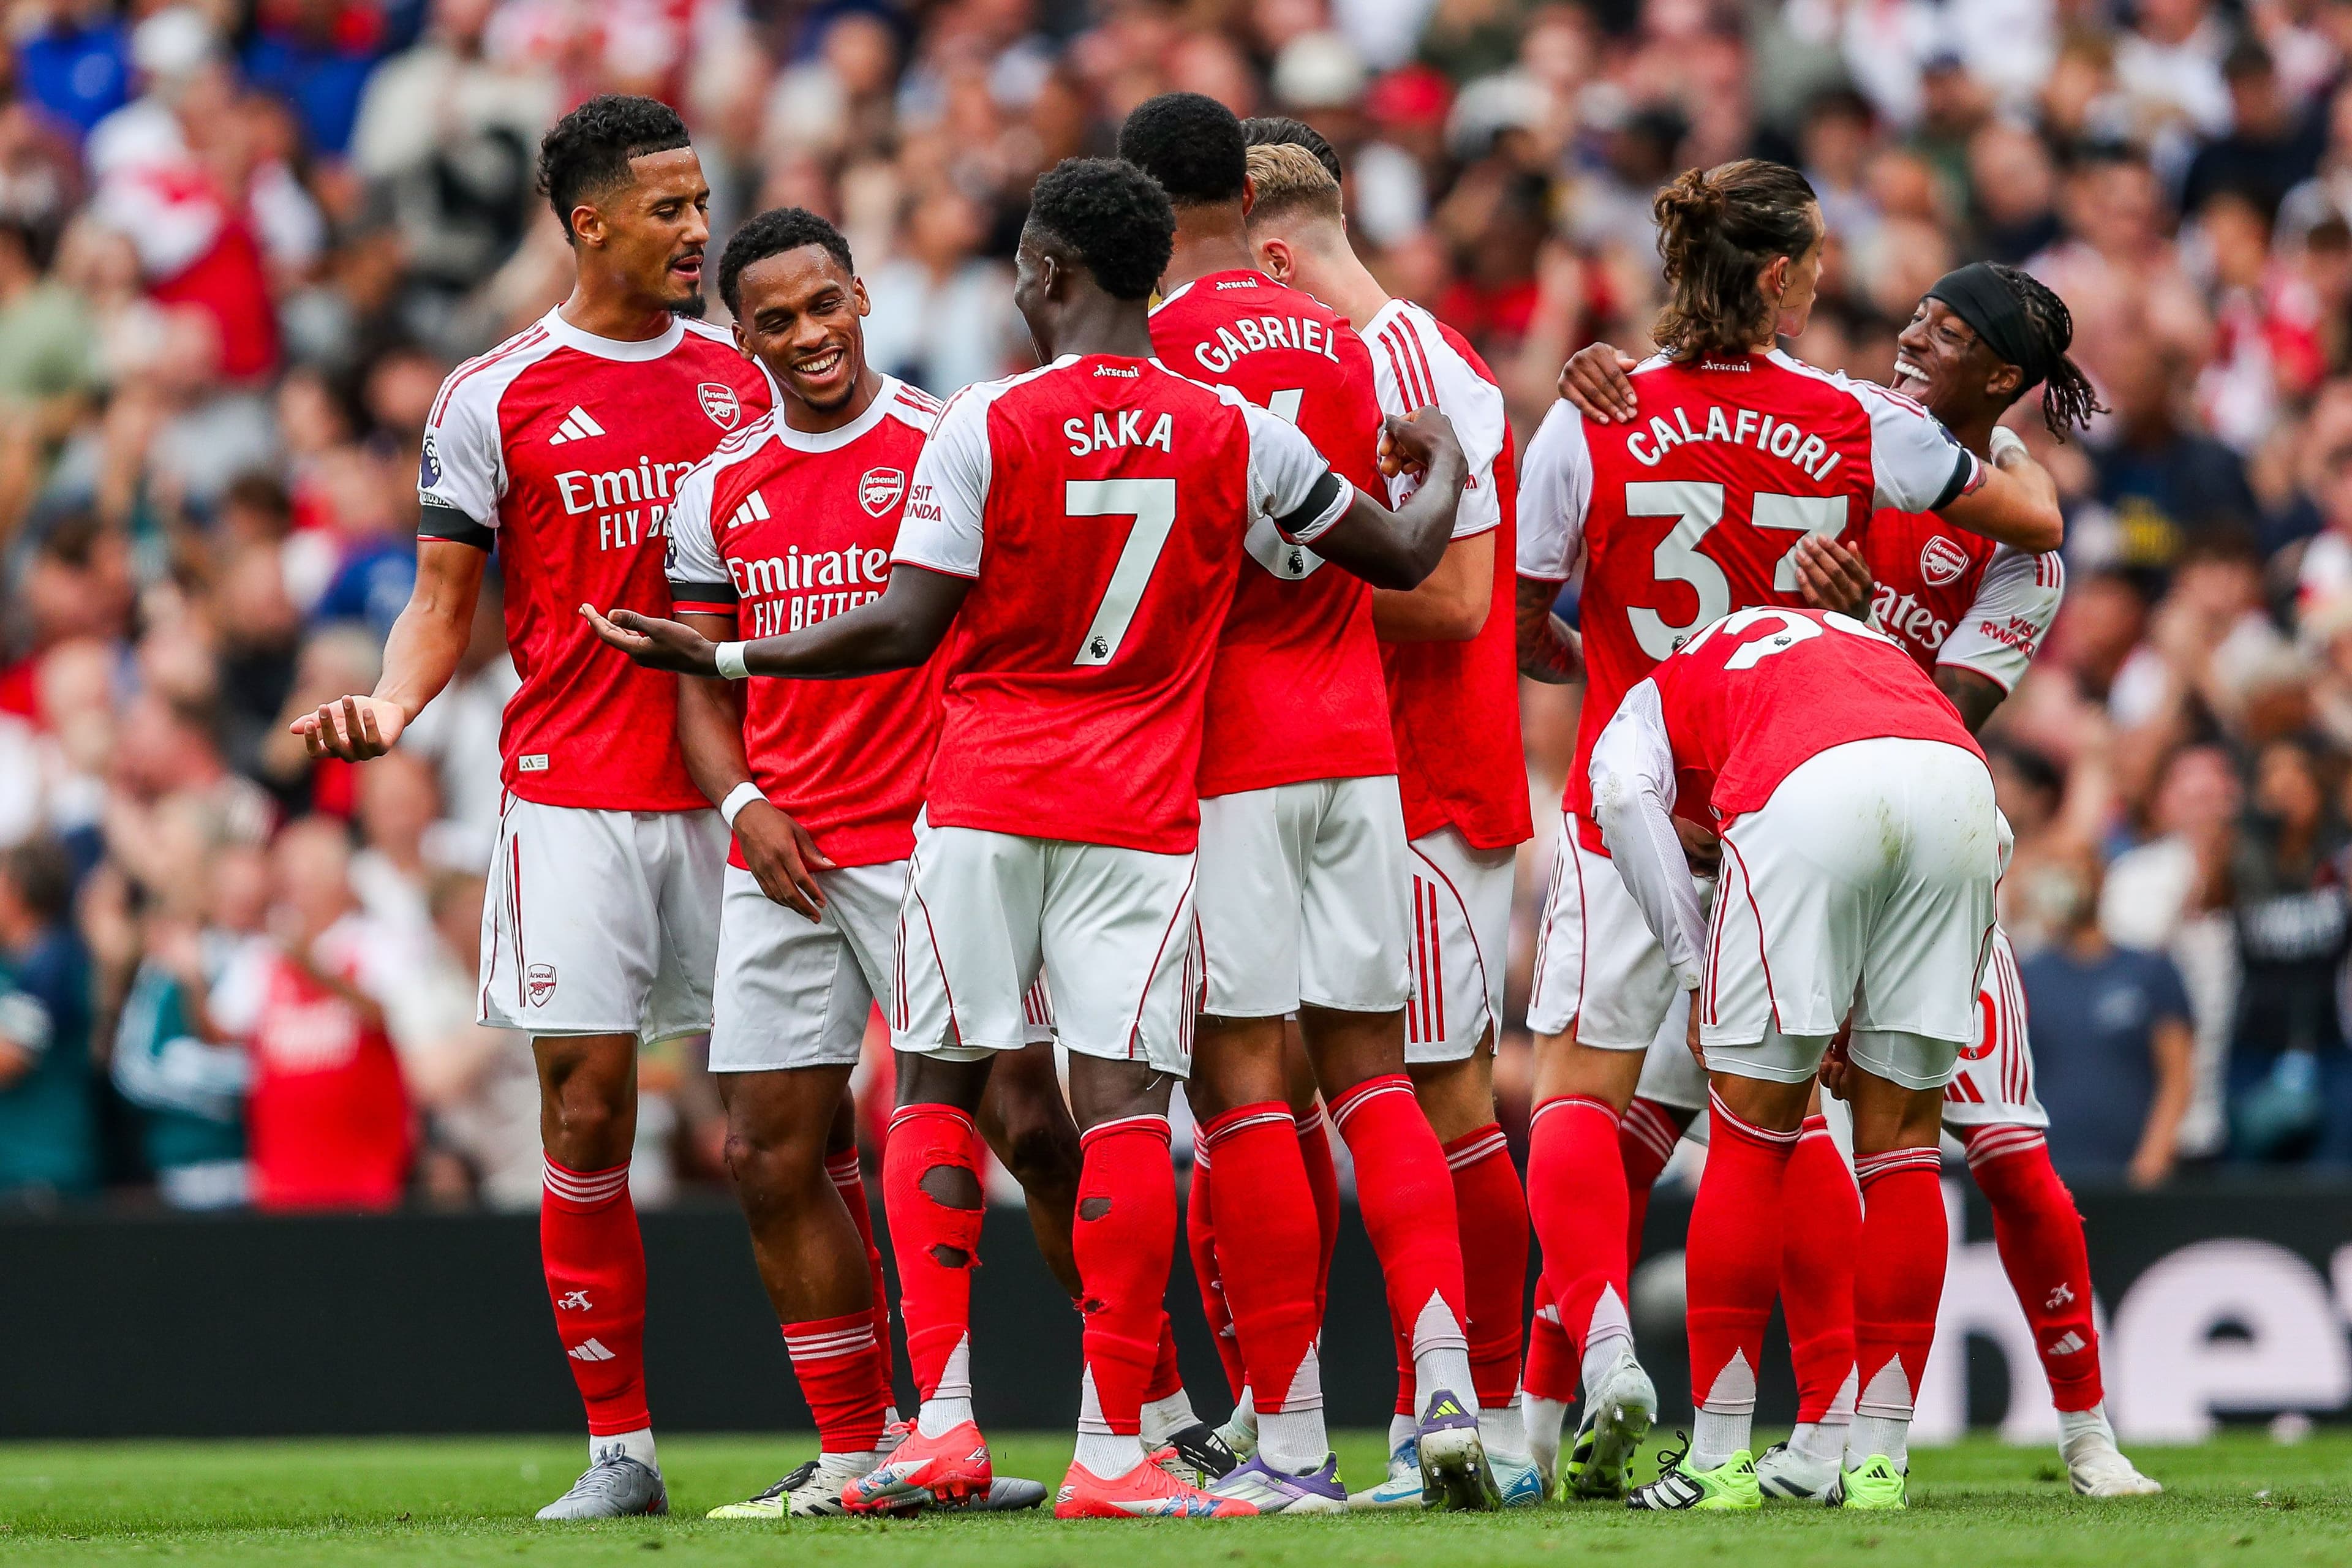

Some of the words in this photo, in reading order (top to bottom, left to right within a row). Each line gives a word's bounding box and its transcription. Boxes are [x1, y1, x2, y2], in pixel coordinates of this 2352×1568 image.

[1194, 315, 1340, 374] GABRIEL
[1093, 364, 1140, 378] Arsenal
[1063, 409, 1173, 457] SAKA
[1626, 405, 1842, 482] CALAFIORI
[866, 476, 898, 484] Arsenal
[599, 509, 640, 551] FLY
[1065, 478, 1176, 666] 7
[753, 598, 785, 638] FLY
